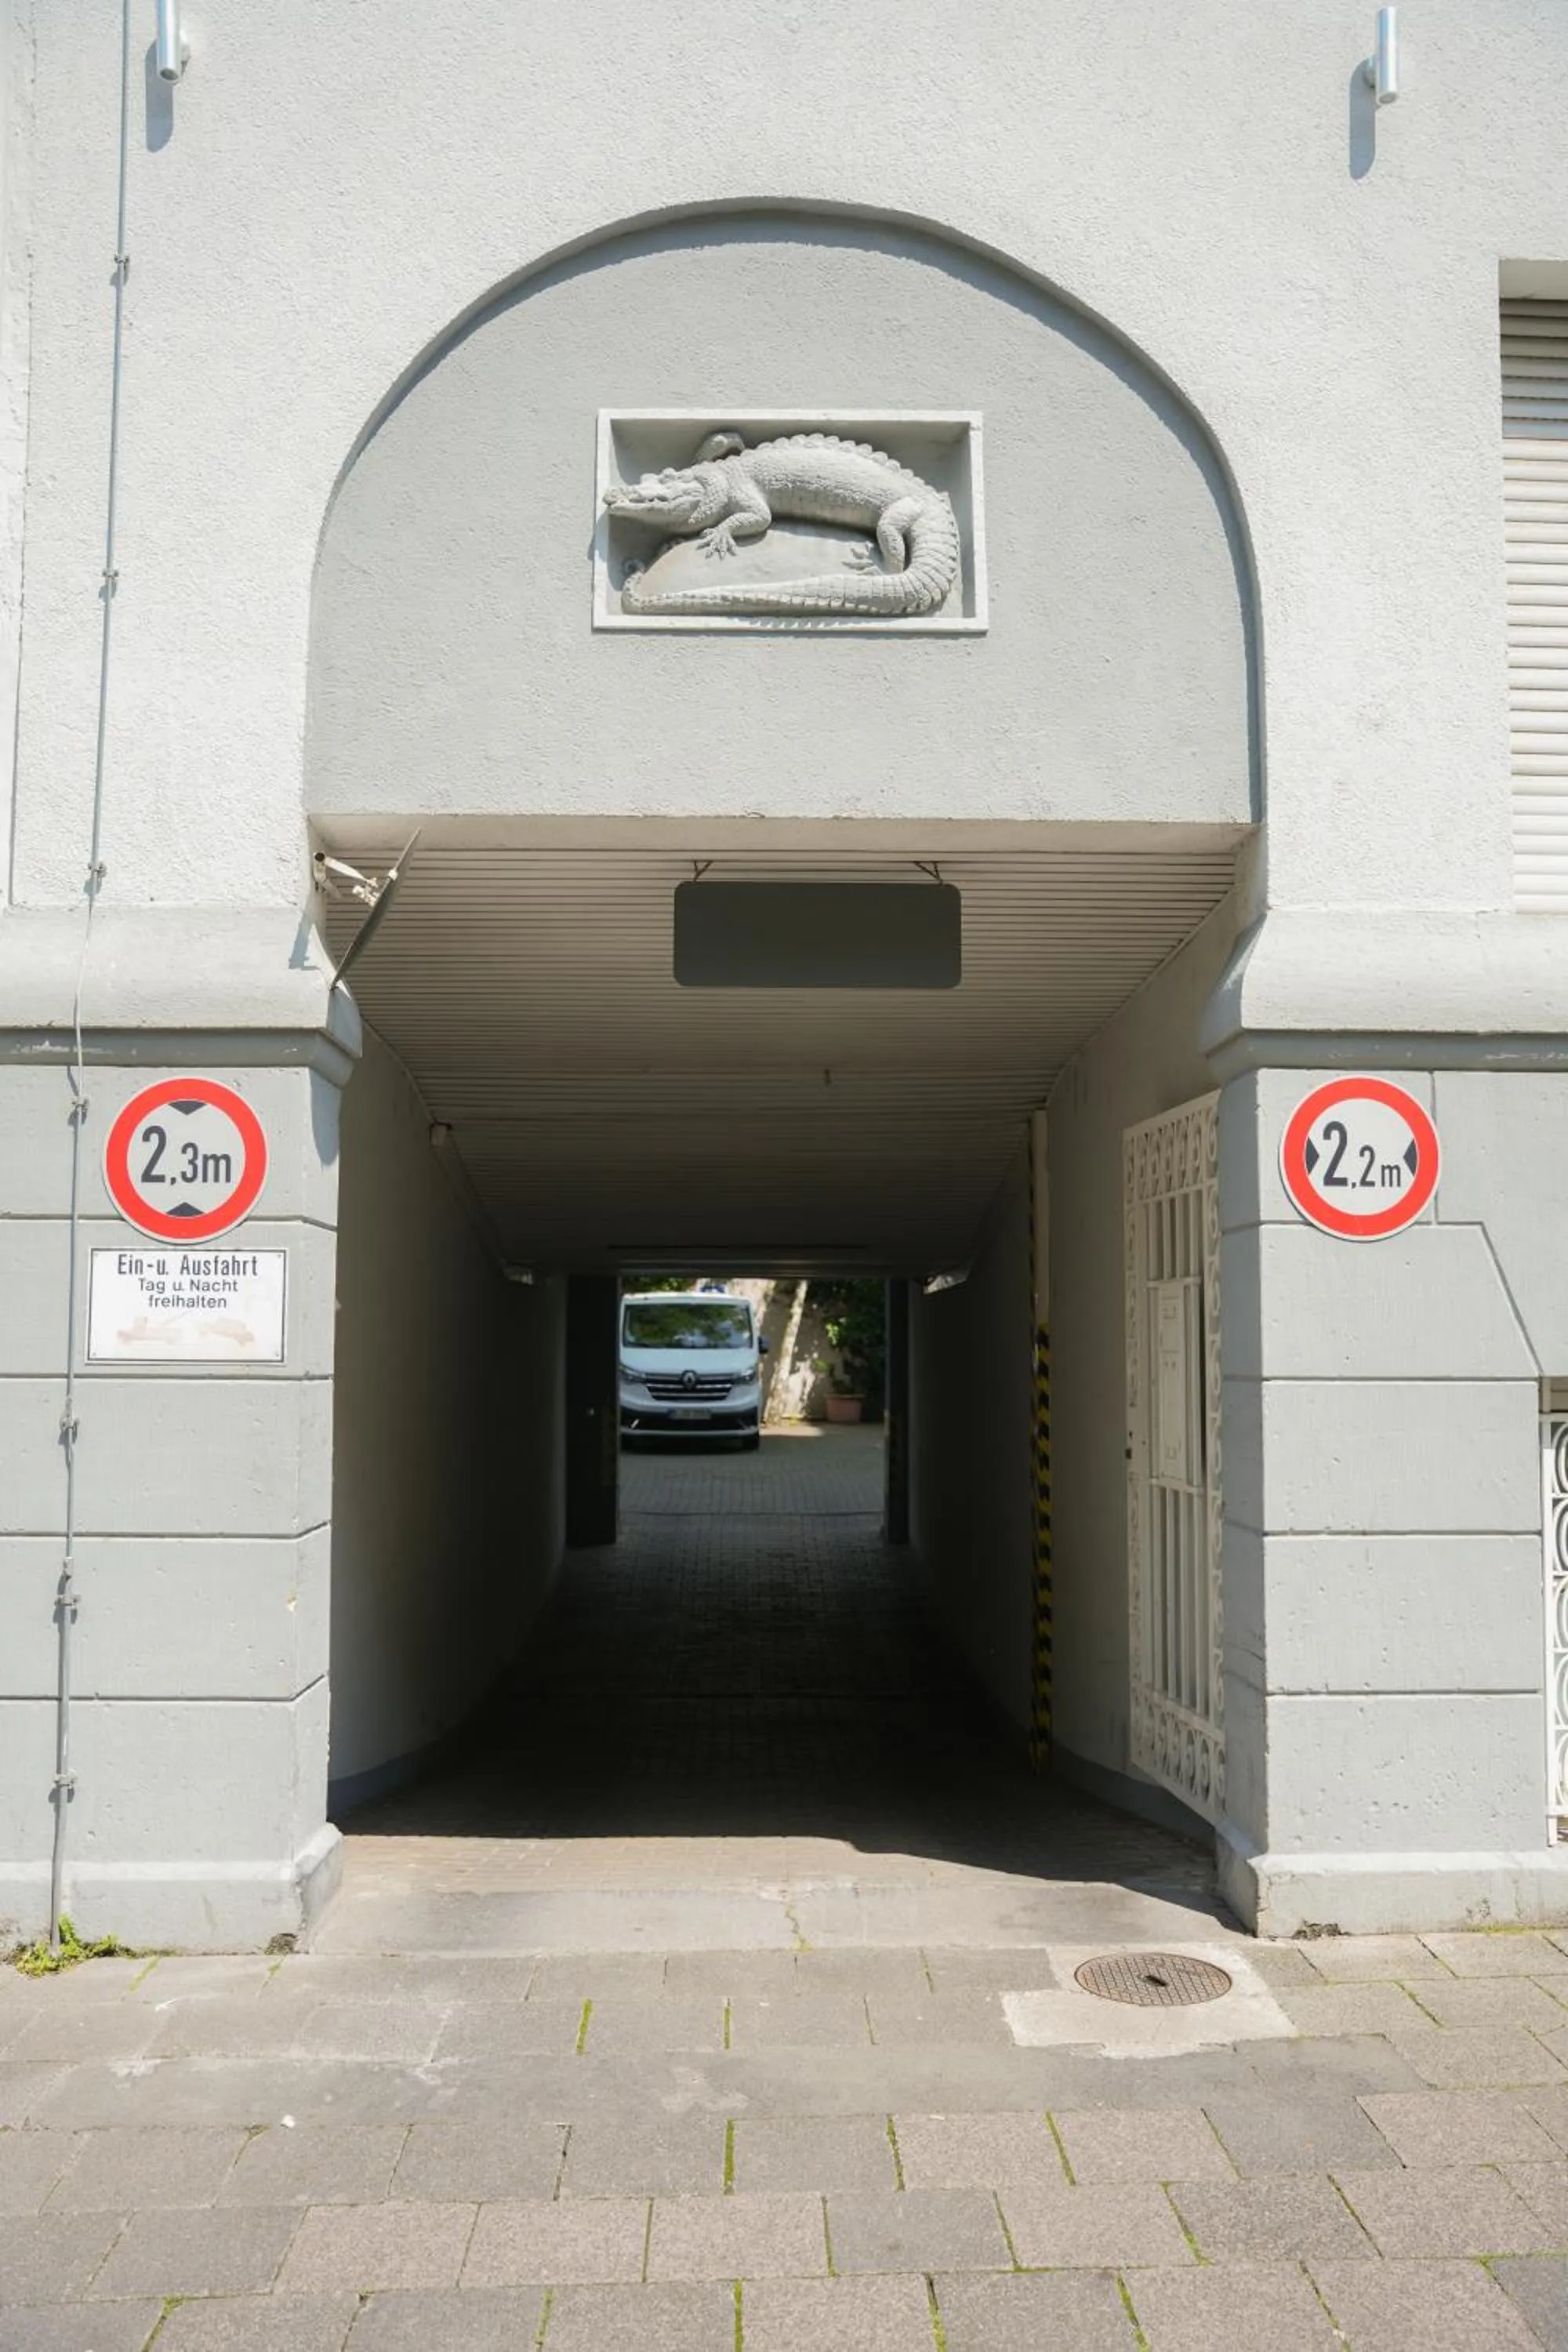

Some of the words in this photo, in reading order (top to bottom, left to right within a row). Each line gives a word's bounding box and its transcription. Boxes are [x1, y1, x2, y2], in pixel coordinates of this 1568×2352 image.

[142, 1125, 231, 1185] 2,3m
[180, 1254, 258, 1276] Ausfahrt
[138, 1278, 165, 1294] Tag
[190, 1279, 238, 1293] Nacht
[148, 1295, 227, 1308] freihalten
